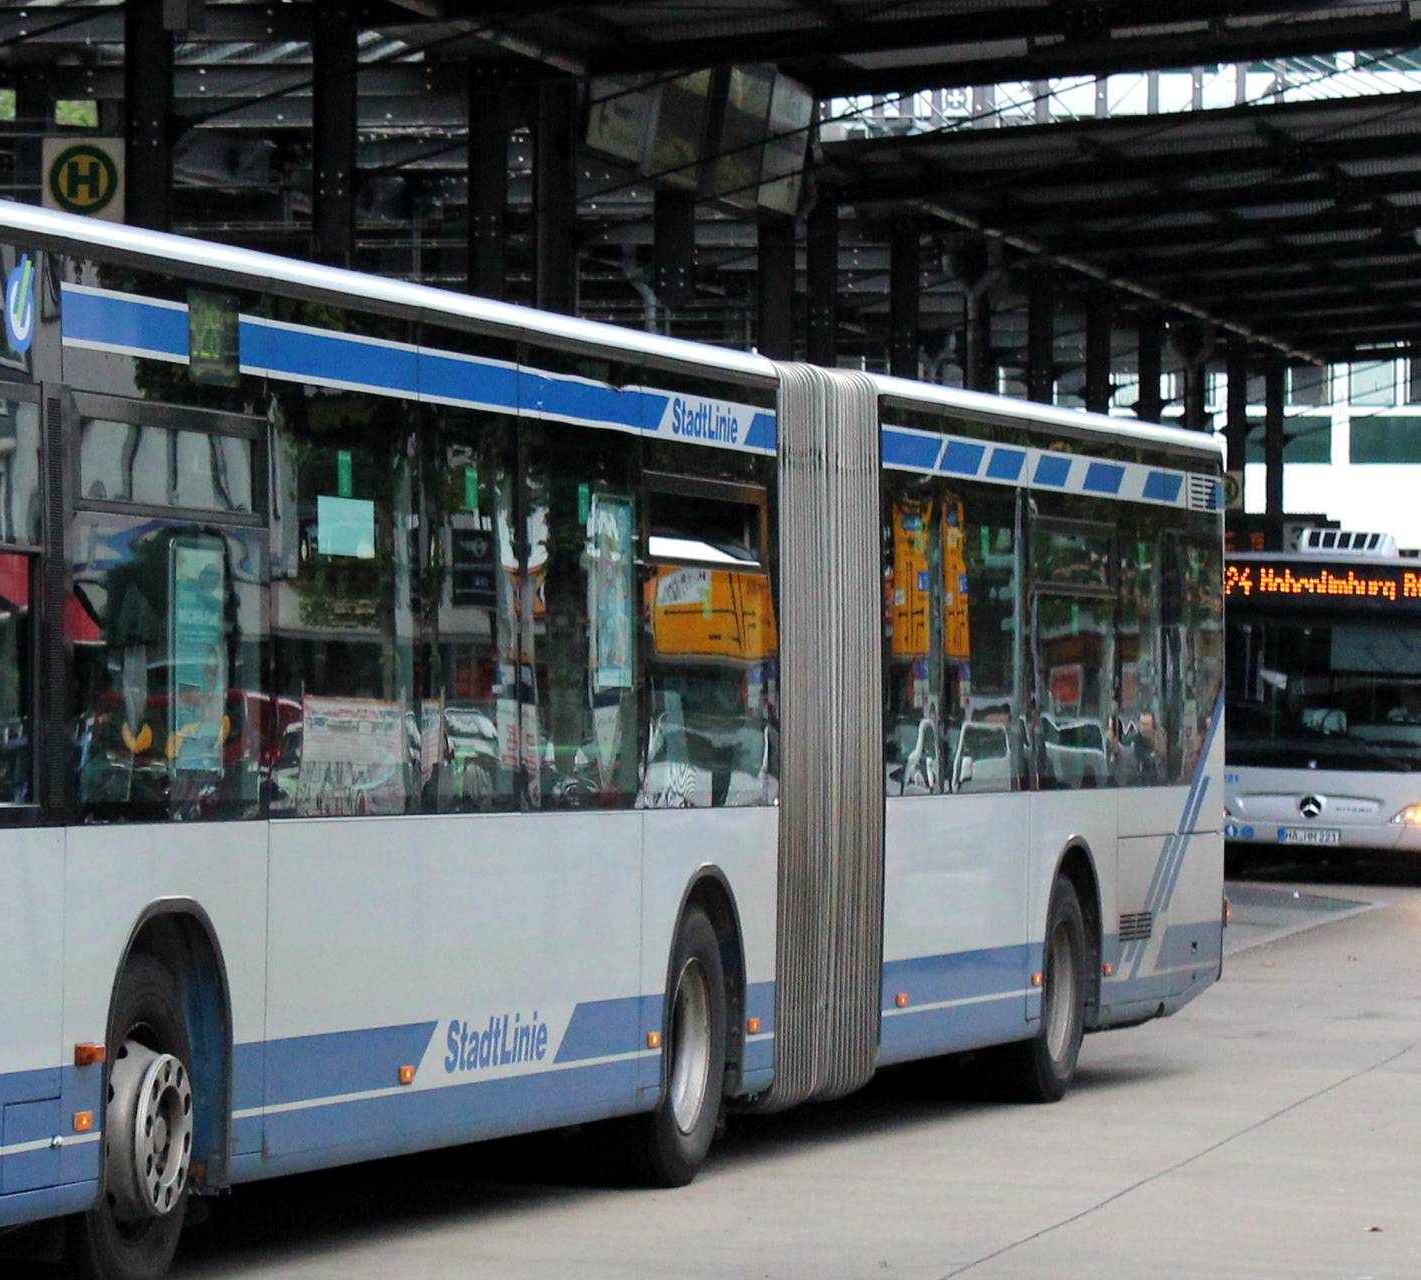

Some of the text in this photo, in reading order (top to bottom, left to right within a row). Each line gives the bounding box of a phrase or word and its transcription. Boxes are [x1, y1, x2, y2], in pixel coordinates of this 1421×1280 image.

[67, 162, 100, 198] H
[672, 397, 739, 444] StadtLinie
[444, 1011, 548, 1074] StadtLinie
